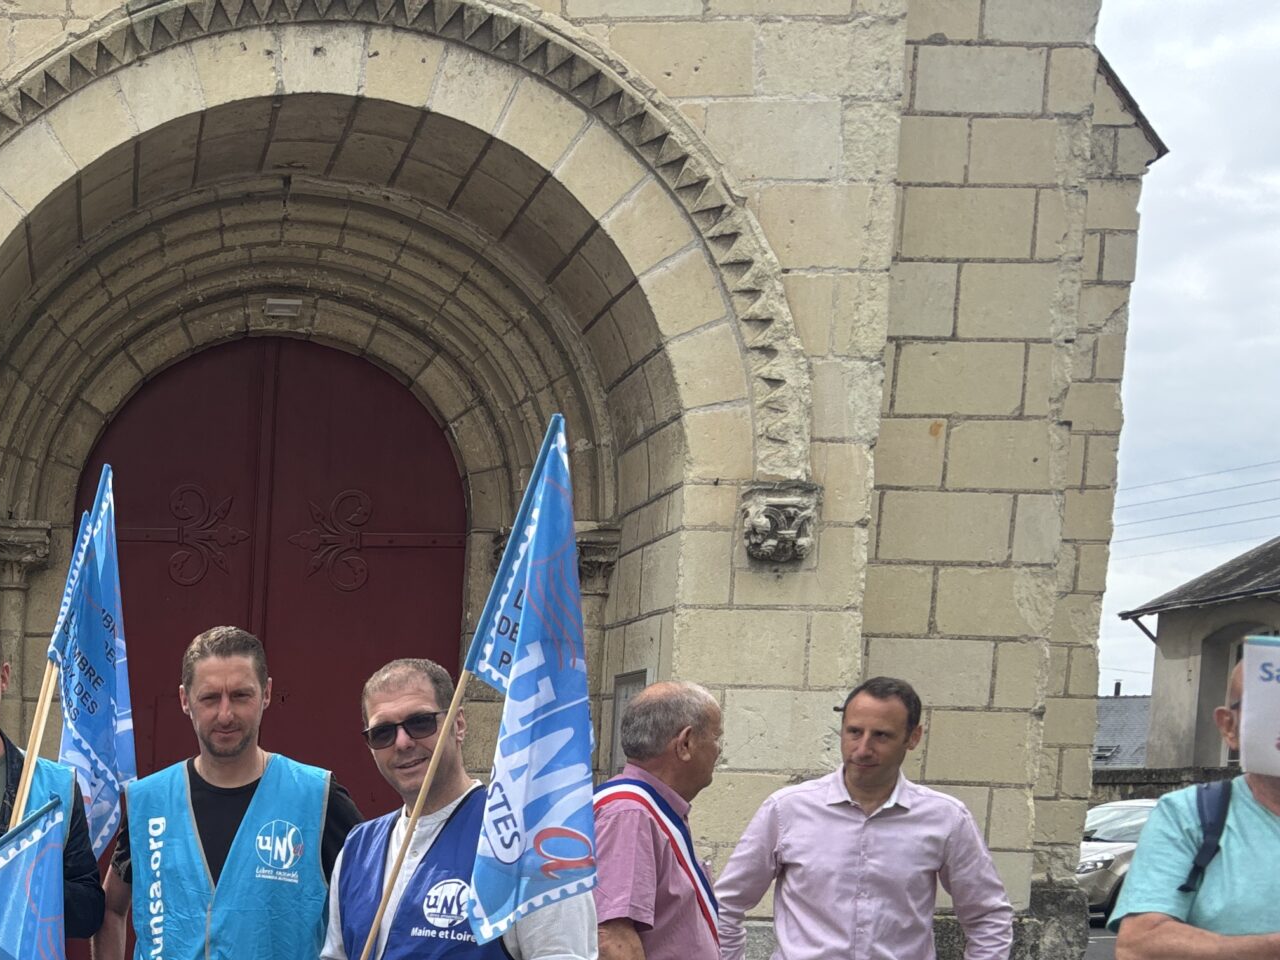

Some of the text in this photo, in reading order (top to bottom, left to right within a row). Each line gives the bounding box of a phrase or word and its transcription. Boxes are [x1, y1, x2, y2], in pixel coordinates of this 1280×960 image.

[73, 681, 98, 715] DES
[487, 766, 521, 850] STES
[411, 926, 477, 943] Maine et Loire
